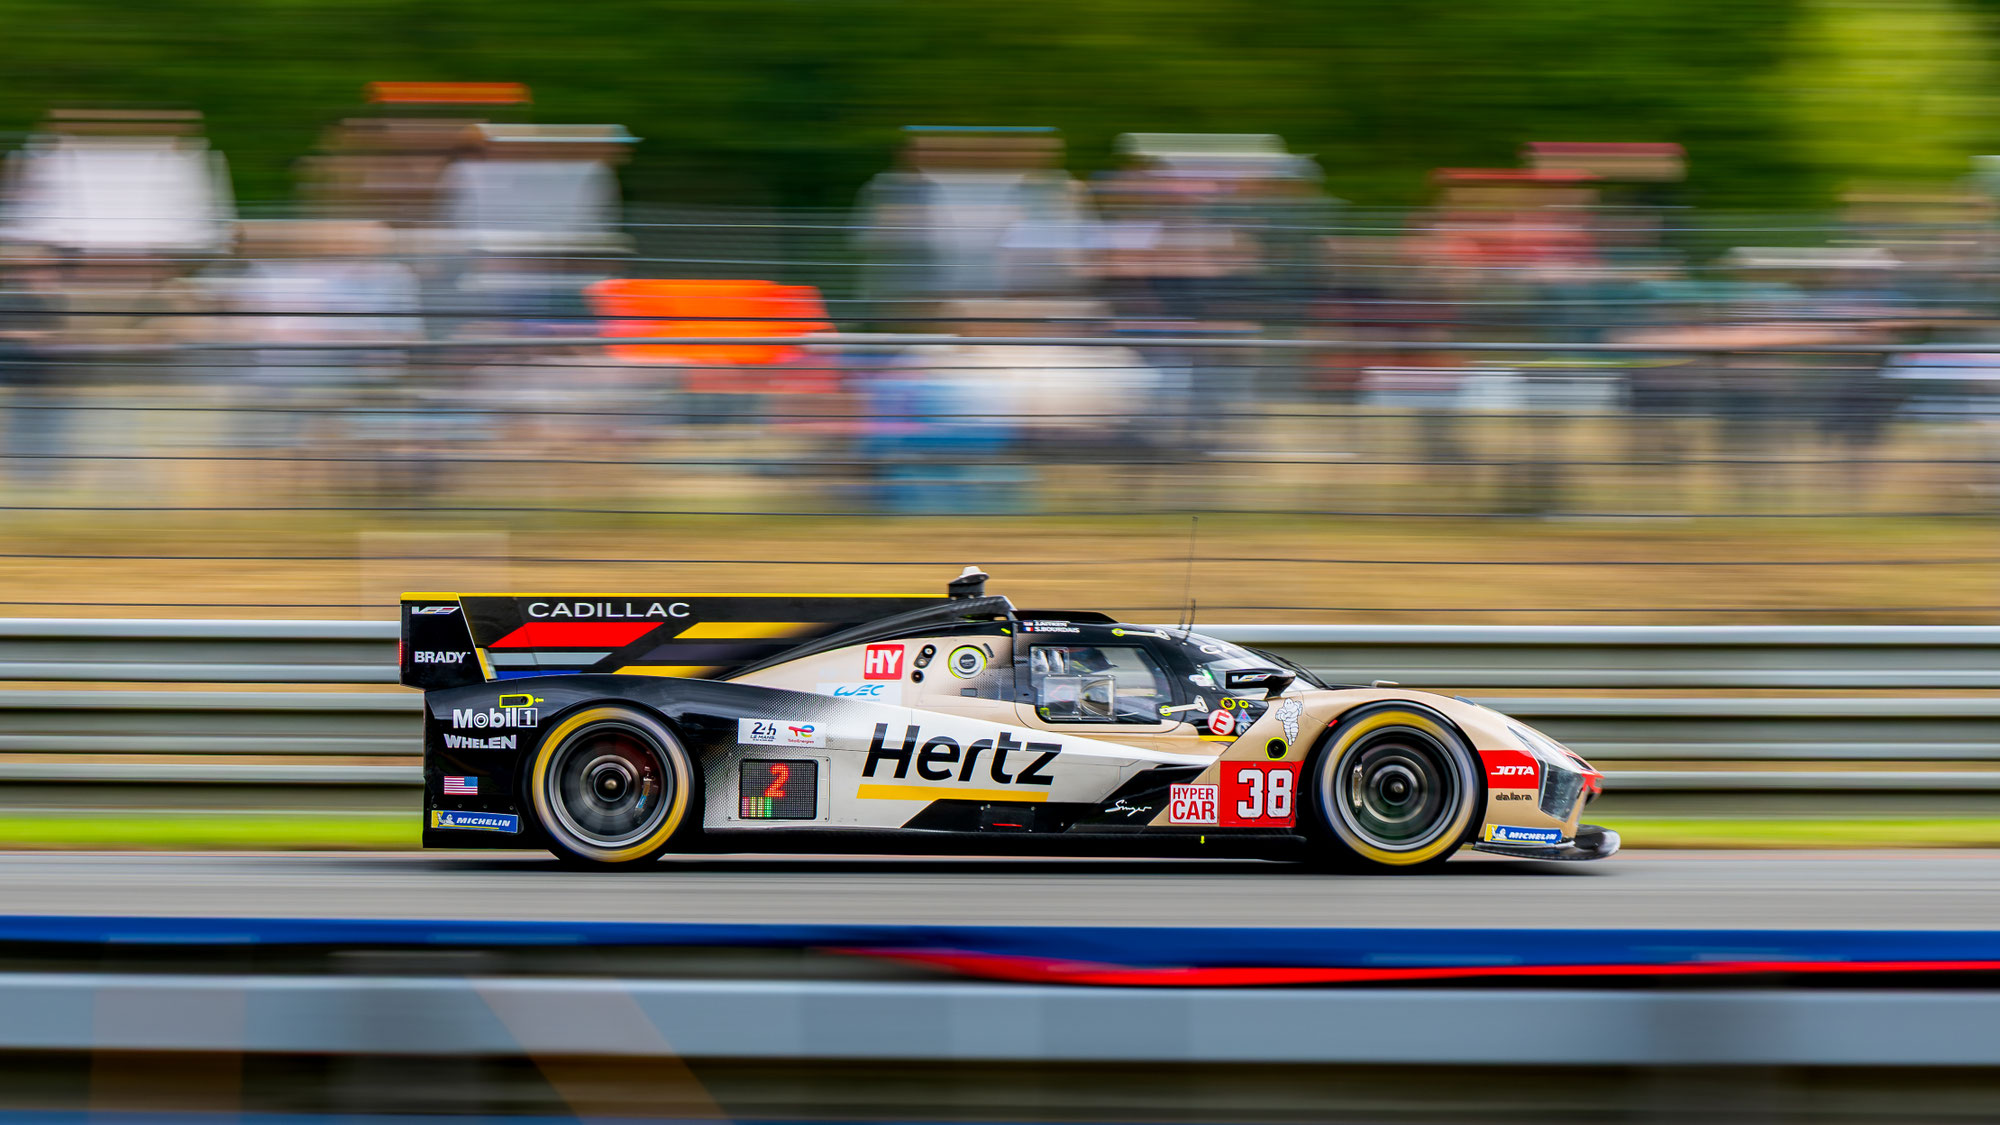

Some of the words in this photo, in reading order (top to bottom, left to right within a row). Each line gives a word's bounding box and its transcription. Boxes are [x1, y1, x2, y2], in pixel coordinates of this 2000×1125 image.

[528, 602, 690, 618] CADILLAC
[414, 651, 466, 663] BRADY
[866, 650, 902, 674] HY
[833, 684, 885, 697] WEC
[453, 707, 517, 728] Mobil
[1212, 710, 1230, 734] E
[443, 733, 517, 749] WHELEN
[861, 722, 1063, 786] Hertz
[1490, 765, 1535, 776] JOTA
[764, 762, 790, 798] 2
[1172, 787, 1214, 800] HYPER
[1236, 768, 1294, 819] 38
[1495, 792, 1533, 802] dallara
[1105, 799, 1152, 817] Singer
[1172, 800, 1215, 820] CAR
[456, 816, 511, 827] MICHELIN
[1508, 831, 1558, 841] MICHELIN
